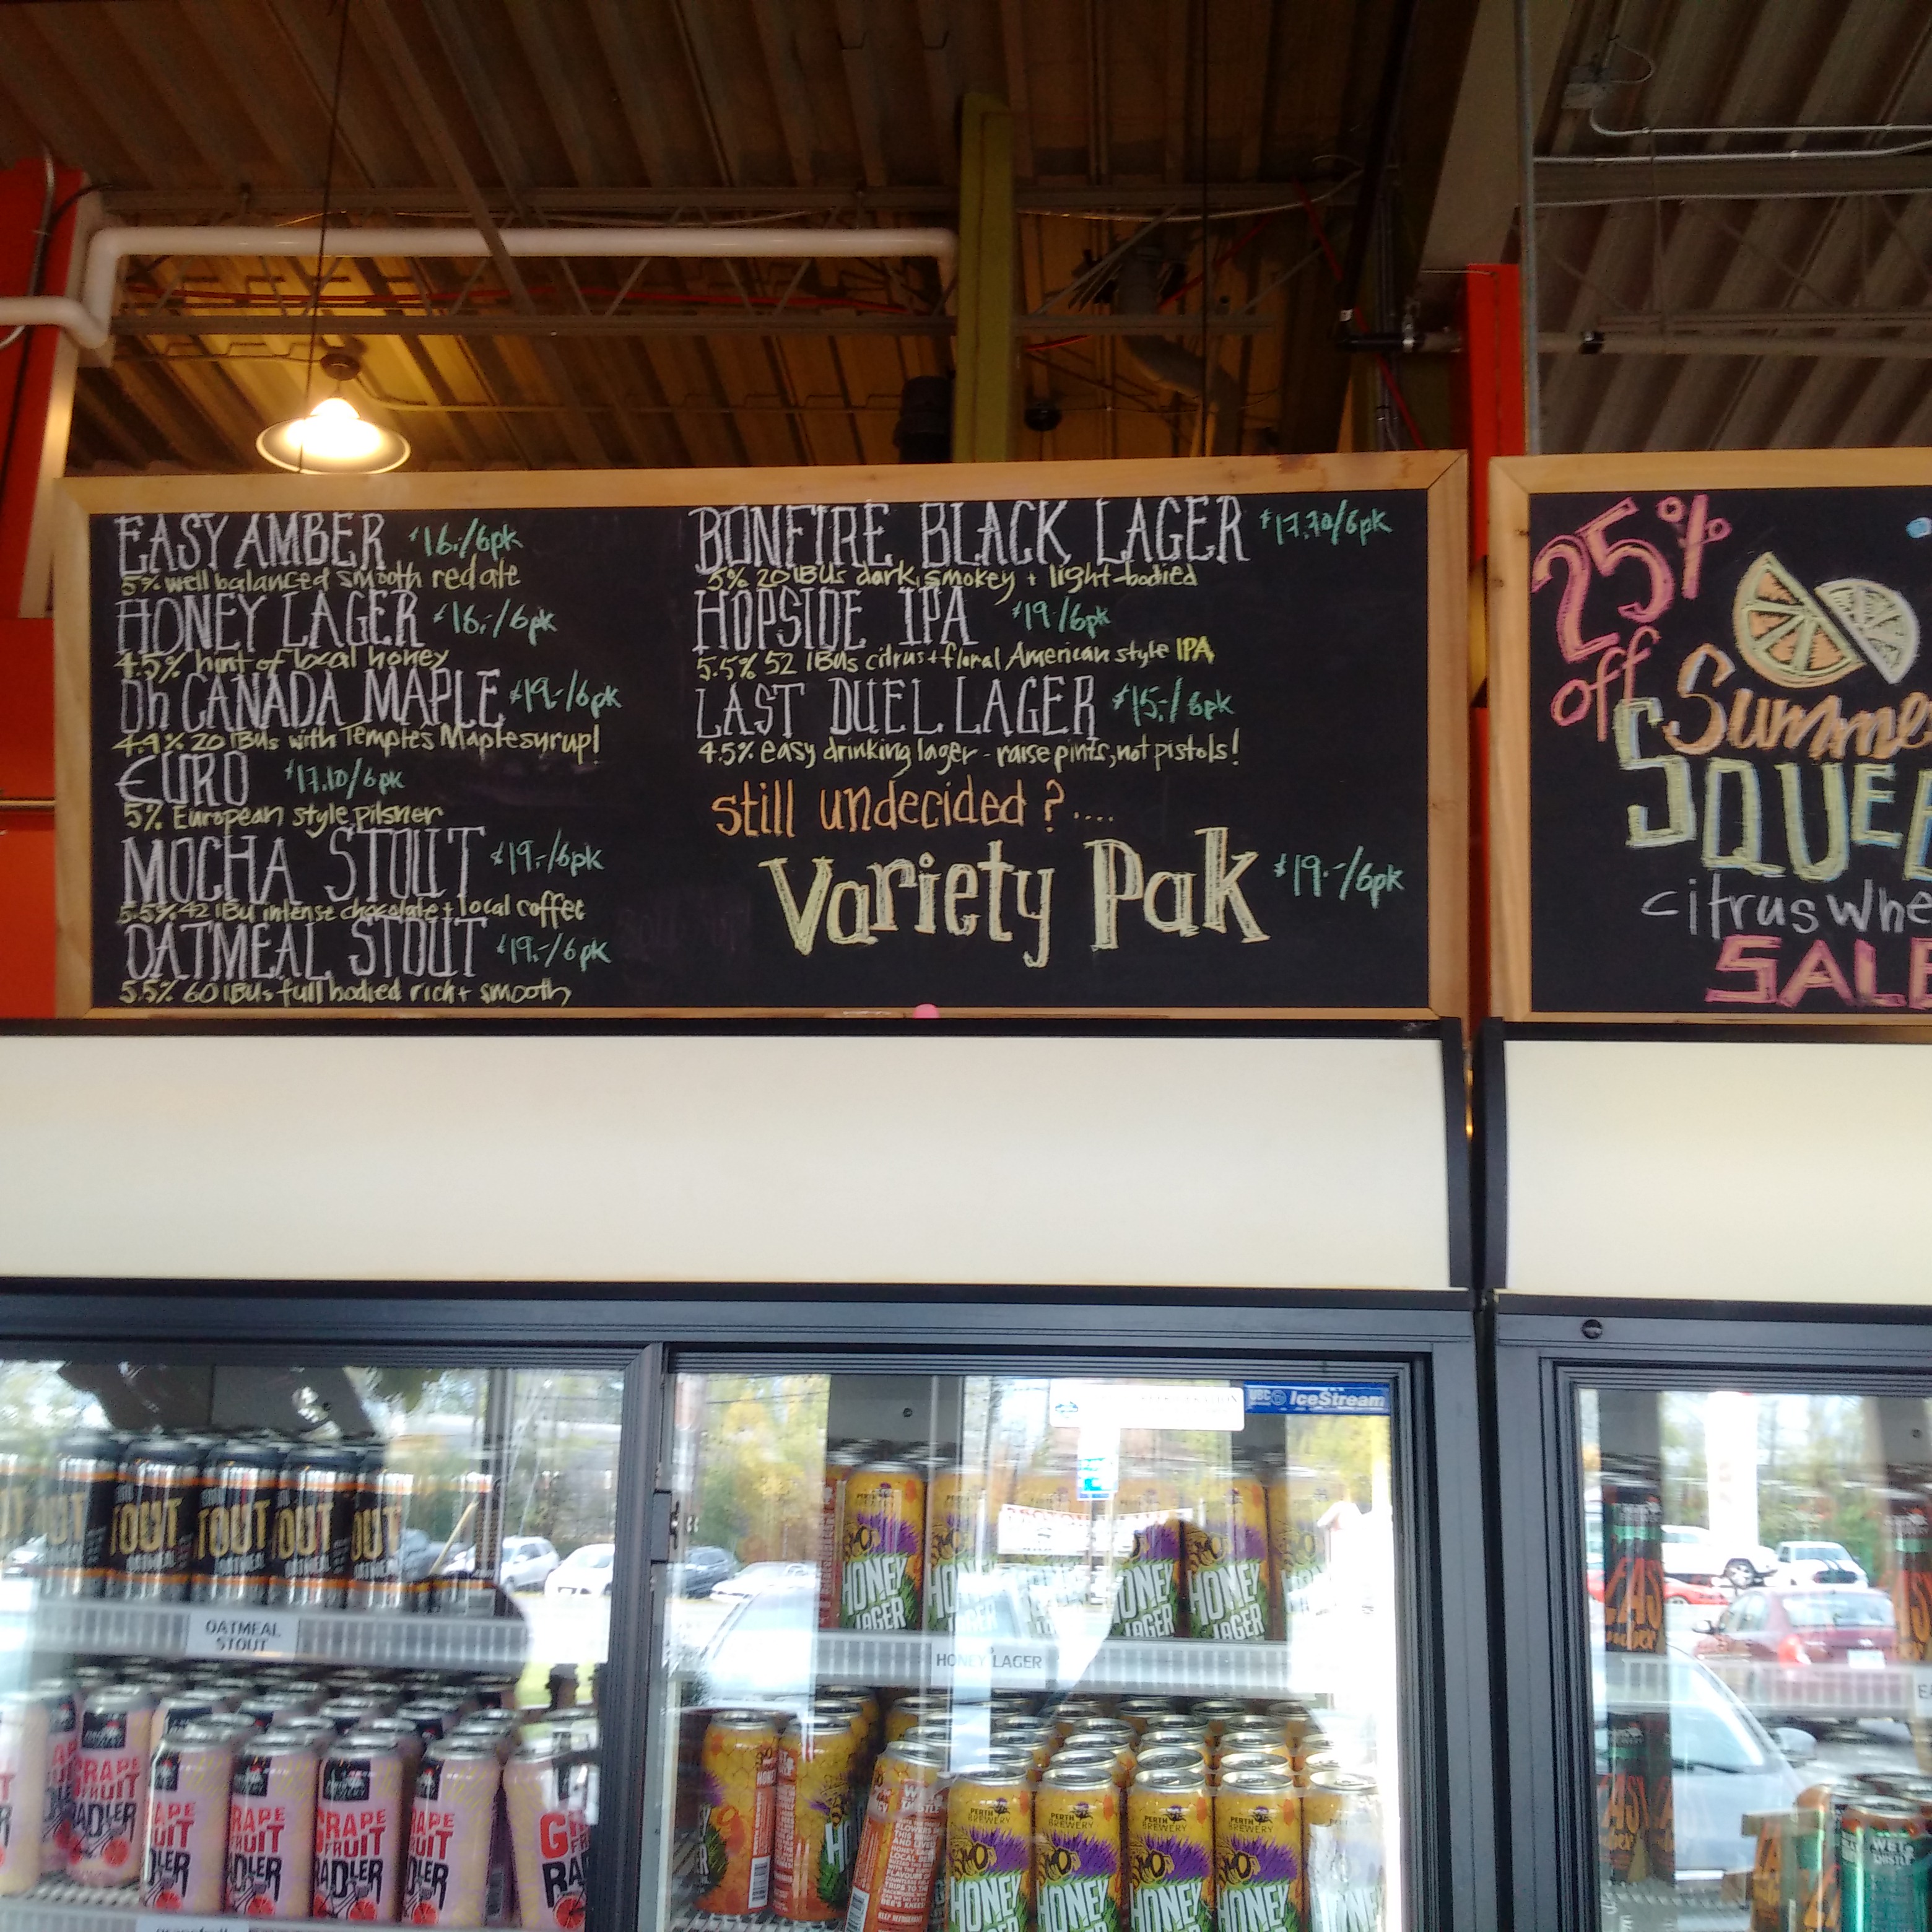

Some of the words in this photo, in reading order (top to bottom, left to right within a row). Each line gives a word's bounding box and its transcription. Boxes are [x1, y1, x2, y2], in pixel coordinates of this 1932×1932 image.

[113, 513, 230, 578] EASY
[233, 511, 386, 570] AMBER
[687, 499, 895, 576] BONFIRE
[919, 498, 1073, 568] BLACK
[1095, 495, 1251, 566] LAGER
[120, 574, 163, 596] 5%
[163, 568, 210, 593] well
[214, 565, 331, 592] balanced
[335, 559, 423, 590] smooth
[432, 552, 478, 591] red
[479, 557, 522, 590] ale
[706, 565, 750, 591] 5%
[922, 565, 1017, 606] smokey
[1531, 494, 1733, 664] 25%
[114, 591, 268, 657] HONEY
[282, 588, 426, 650] LAGER
[692, 585, 868, 656] HOPSIDE
[897, 584, 980, 646] IPA
[194, 648, 255, 674] hint
[292, 644, 358, 669] local
[368, 645, 450, 670] honey
[695, 653, 759, 681] 5.5%
[763, 650, 799, 676] 52
[866, 644, 925, 671] citrus
[941, 640, 1001, 671] floral
[1003, 640, 1112, 672] American
[1113, 640, 1170, 670] style
[1175, 635, 1216, 665] IPA
[181, 669, 348, 733] CANADA
[361, 665, 507, 728] MAPLE
[1551, 624, 1661, 742] off
[1662, 642, 1932, 760] Summe
[694, 682, 806, 739] LAST
[827, 677, 944, 735] DUEL
[955, 674, 1100, 741] LAGER
[287, 728, 336, 750] with
[697, 740, 755, 766] 4.5%
[760, 739, 817, 769] easy
[822, 736, 913, 778] drinking
[916, 736, 980, 775] lager
[996, 742, 1053, 768] raise
[123, 804, 164, 831] 5%
[172, 804, 286, 836] European
[292, 803, 349, 838] style
[711, 778, 796, 838] still
[818, 773, 1029, 833] undecided
[120, 833, 305, 906] MOCHA
[323, 824, 488, 903] STOUT
[262, 897, 338, 921] intense
[339, 895, 439, 920] chocolate
[459, 892, 511, 916] local
[515, 889, 587, 929] coffee
[757, 838, 1055, 970] Variety
[1082, 826, 1272, 952] Pak
[123, 920, 333, 981] OATMEAL
[347, 913, 489, 979] STOUT
[183, 981, 220, 1004] 60
[276, 977, 325, 1007] full
[329, 977, 402, 1004] bodied
[409, 977, 457, 1004] rich
[479, 977, 573, 1008] smooth
[1289, 1390, 1386, 1408] IceStream
[842, 1556, 908, 1617] HONEY
[1187, 1562, 1261, 1627] HONEY
[205, 1619, 282, 1638] OATMEAL
[216, 1636, 269, 1652] STOUT
[936, 1652, 987, 1668] HONEY
[992, 1654, 1042, 1669] LAGER
[967, 1814, 1011, 1825] BREWERY
[970, 1807, 993, 1817] PERTH
[1048, 1819, 1094, 1830] BREWERY
[1050, 1812, 1074, 1821] PERTH
[1142, 1822, 1187, 1832] BREWERY
[1144, 1815, 1168, 1824] PERTH
[1228, 1823, 1273, 1834] BREWERY
[1230, 1816, 1254, 1825] PERTH
[950, 1874, 1021, 1932] HONEY
[1036, 1878, 1109, 1932] HONEY
[1129, 1881, 1203, 1932] HONEY
[1216, 1882, 1290, 1932] HONEY
